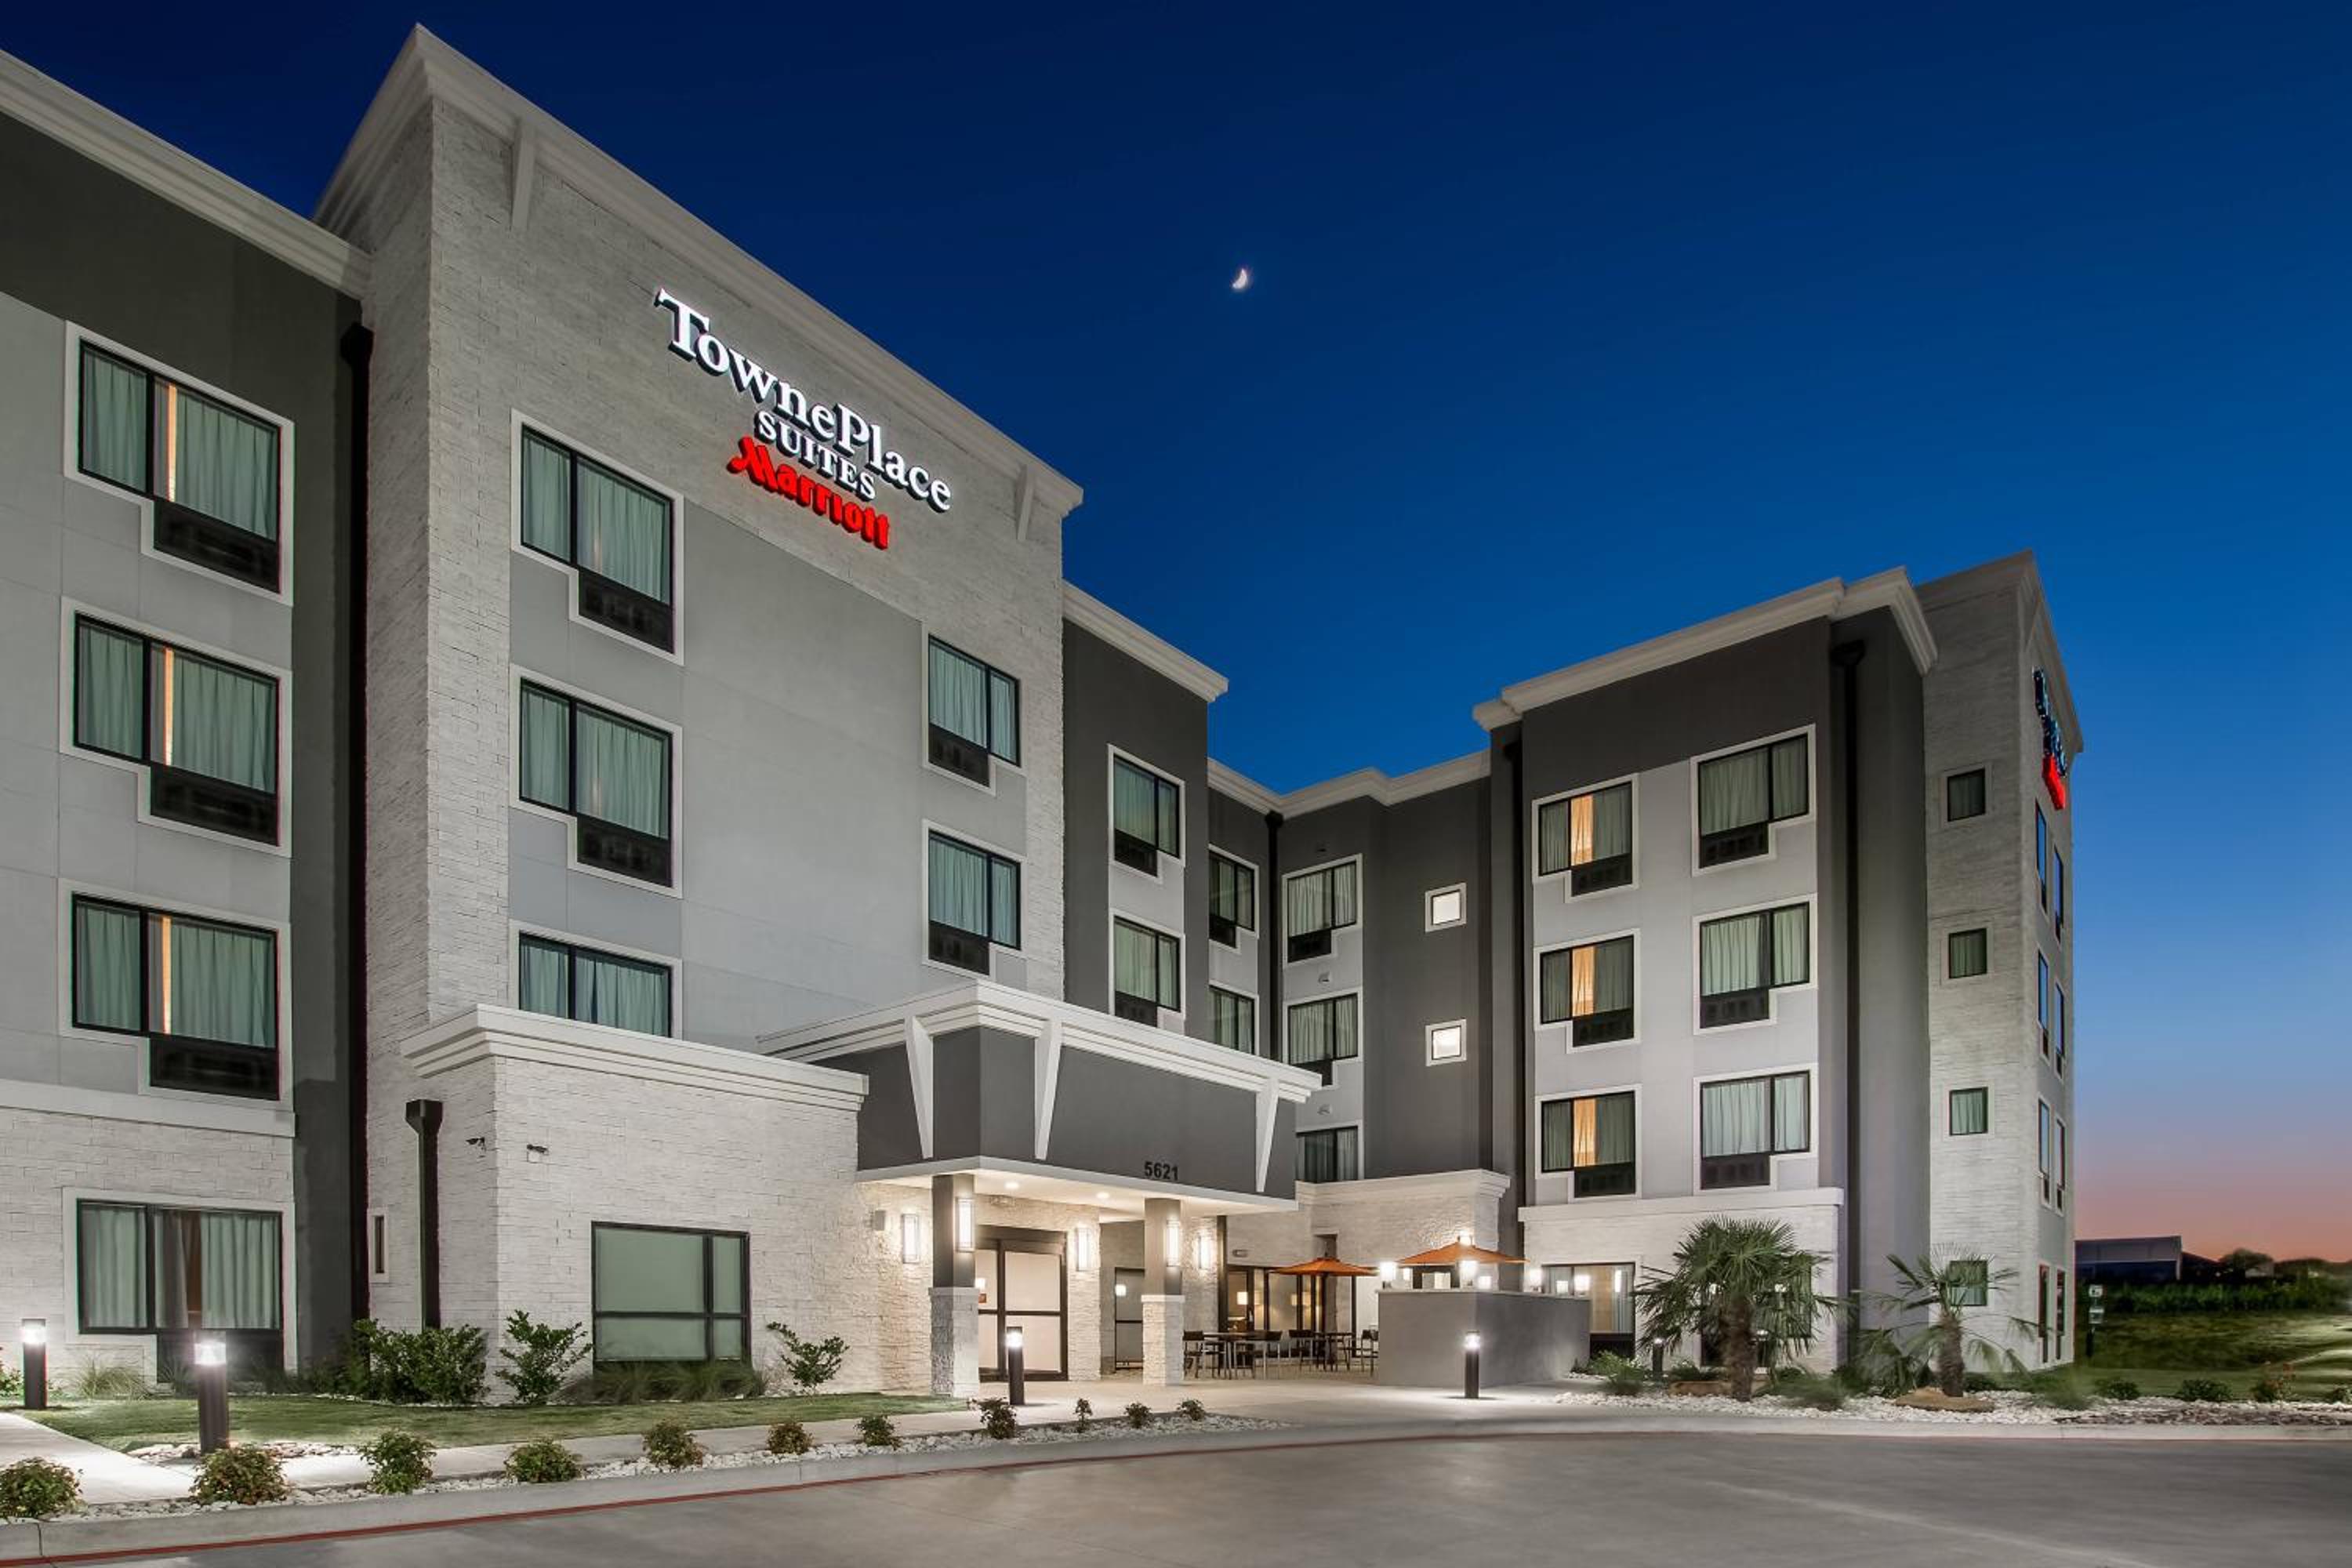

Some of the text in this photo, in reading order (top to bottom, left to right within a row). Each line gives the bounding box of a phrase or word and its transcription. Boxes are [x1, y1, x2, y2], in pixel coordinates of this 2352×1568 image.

[655, 289, 951, 512] TownePlace
[727, 436, 889, 550] Marriott
[755, 409, 877, 500] SUITES
[1145, 1161, 1178, 1181] 5621
